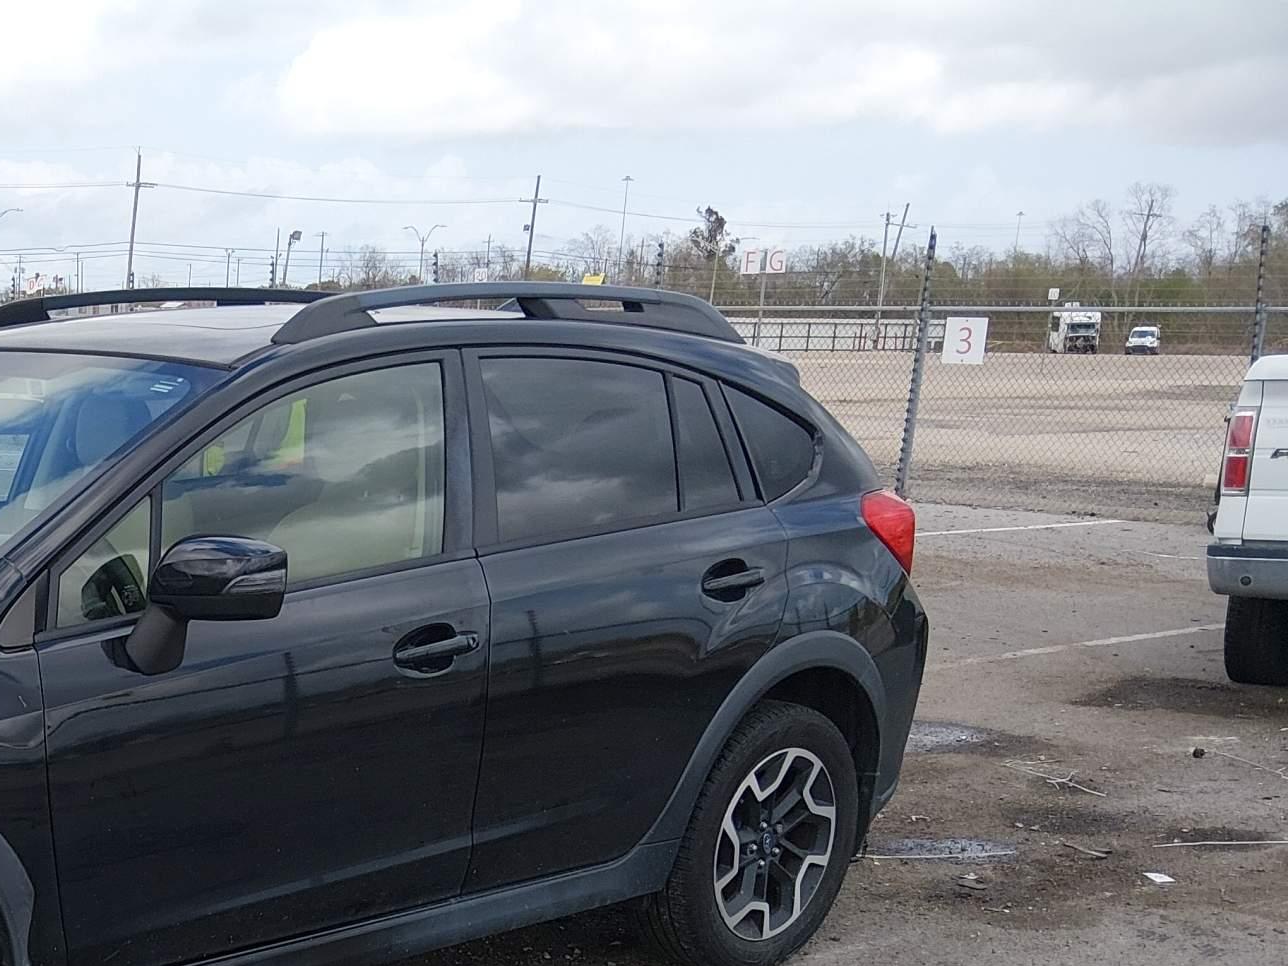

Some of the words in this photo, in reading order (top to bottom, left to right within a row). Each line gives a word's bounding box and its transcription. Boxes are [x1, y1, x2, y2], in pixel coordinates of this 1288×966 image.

[745, 251, 757, 272] F
[769, 250, 784, 271] G
[955, 326, 973, 355] 3
